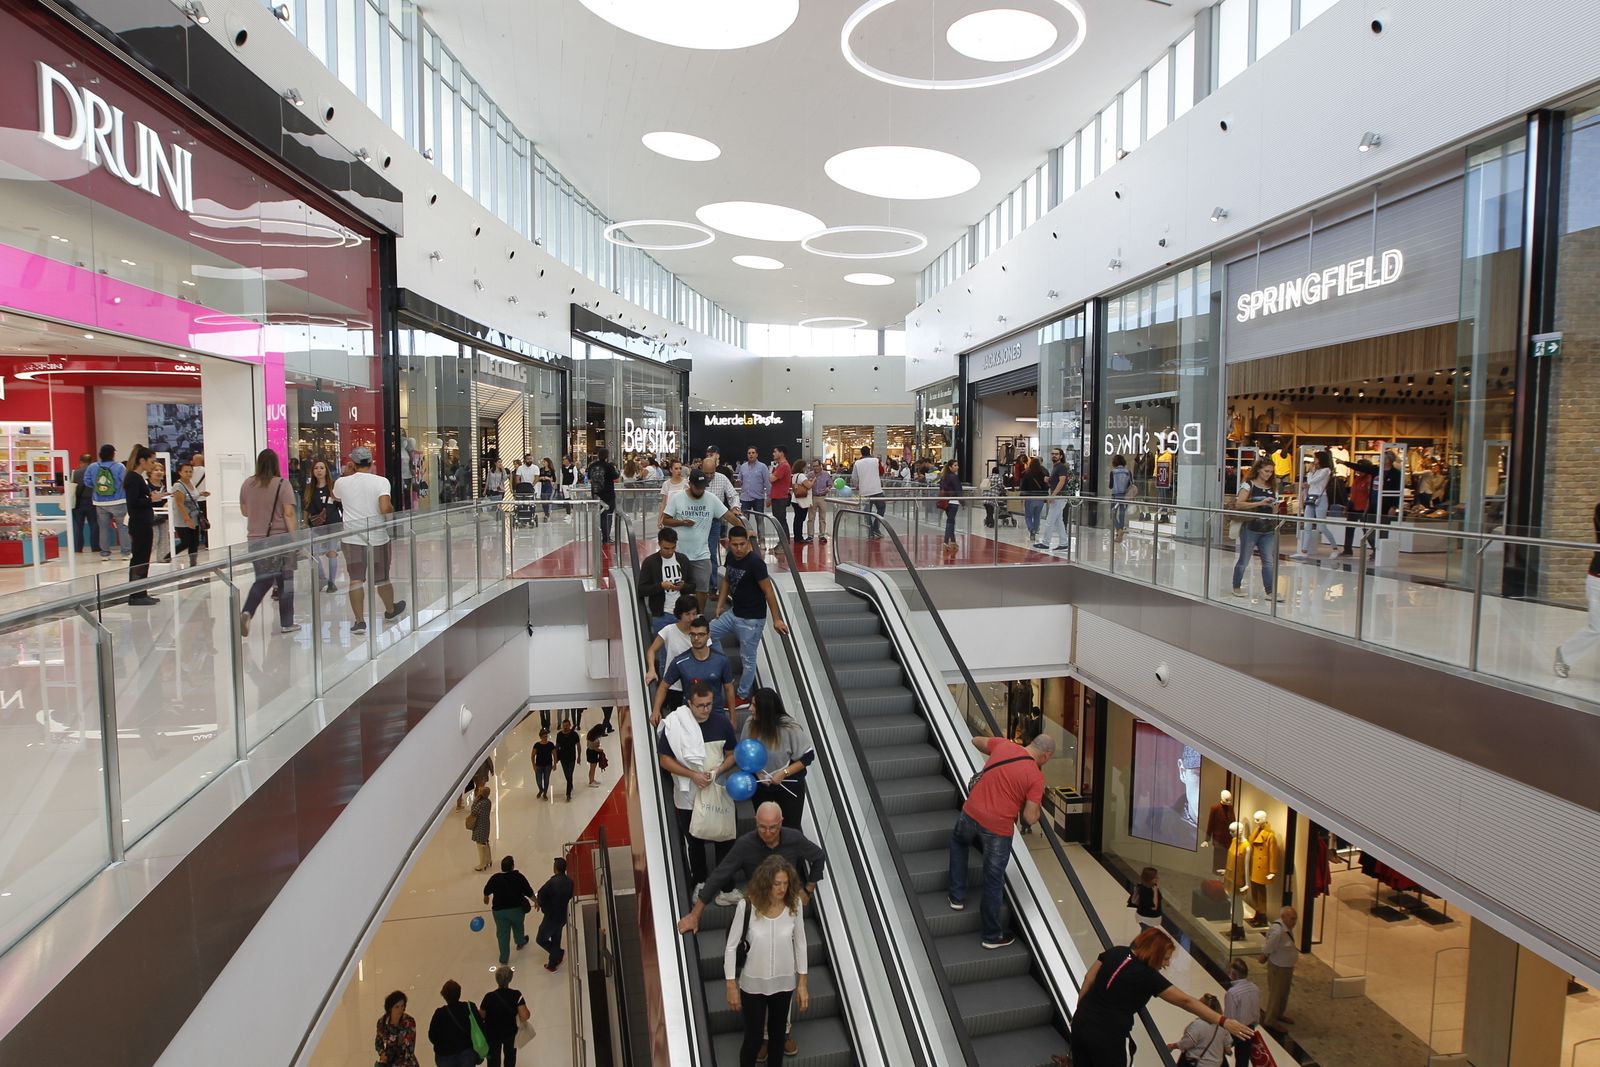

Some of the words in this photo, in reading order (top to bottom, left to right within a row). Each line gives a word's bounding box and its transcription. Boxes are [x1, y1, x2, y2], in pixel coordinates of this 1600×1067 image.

[36, 61, 195, 214] DRUNI
[1236, 248, 1404, 323] SPRINGFIELD
[624, 417, 676, 454] Bershka
